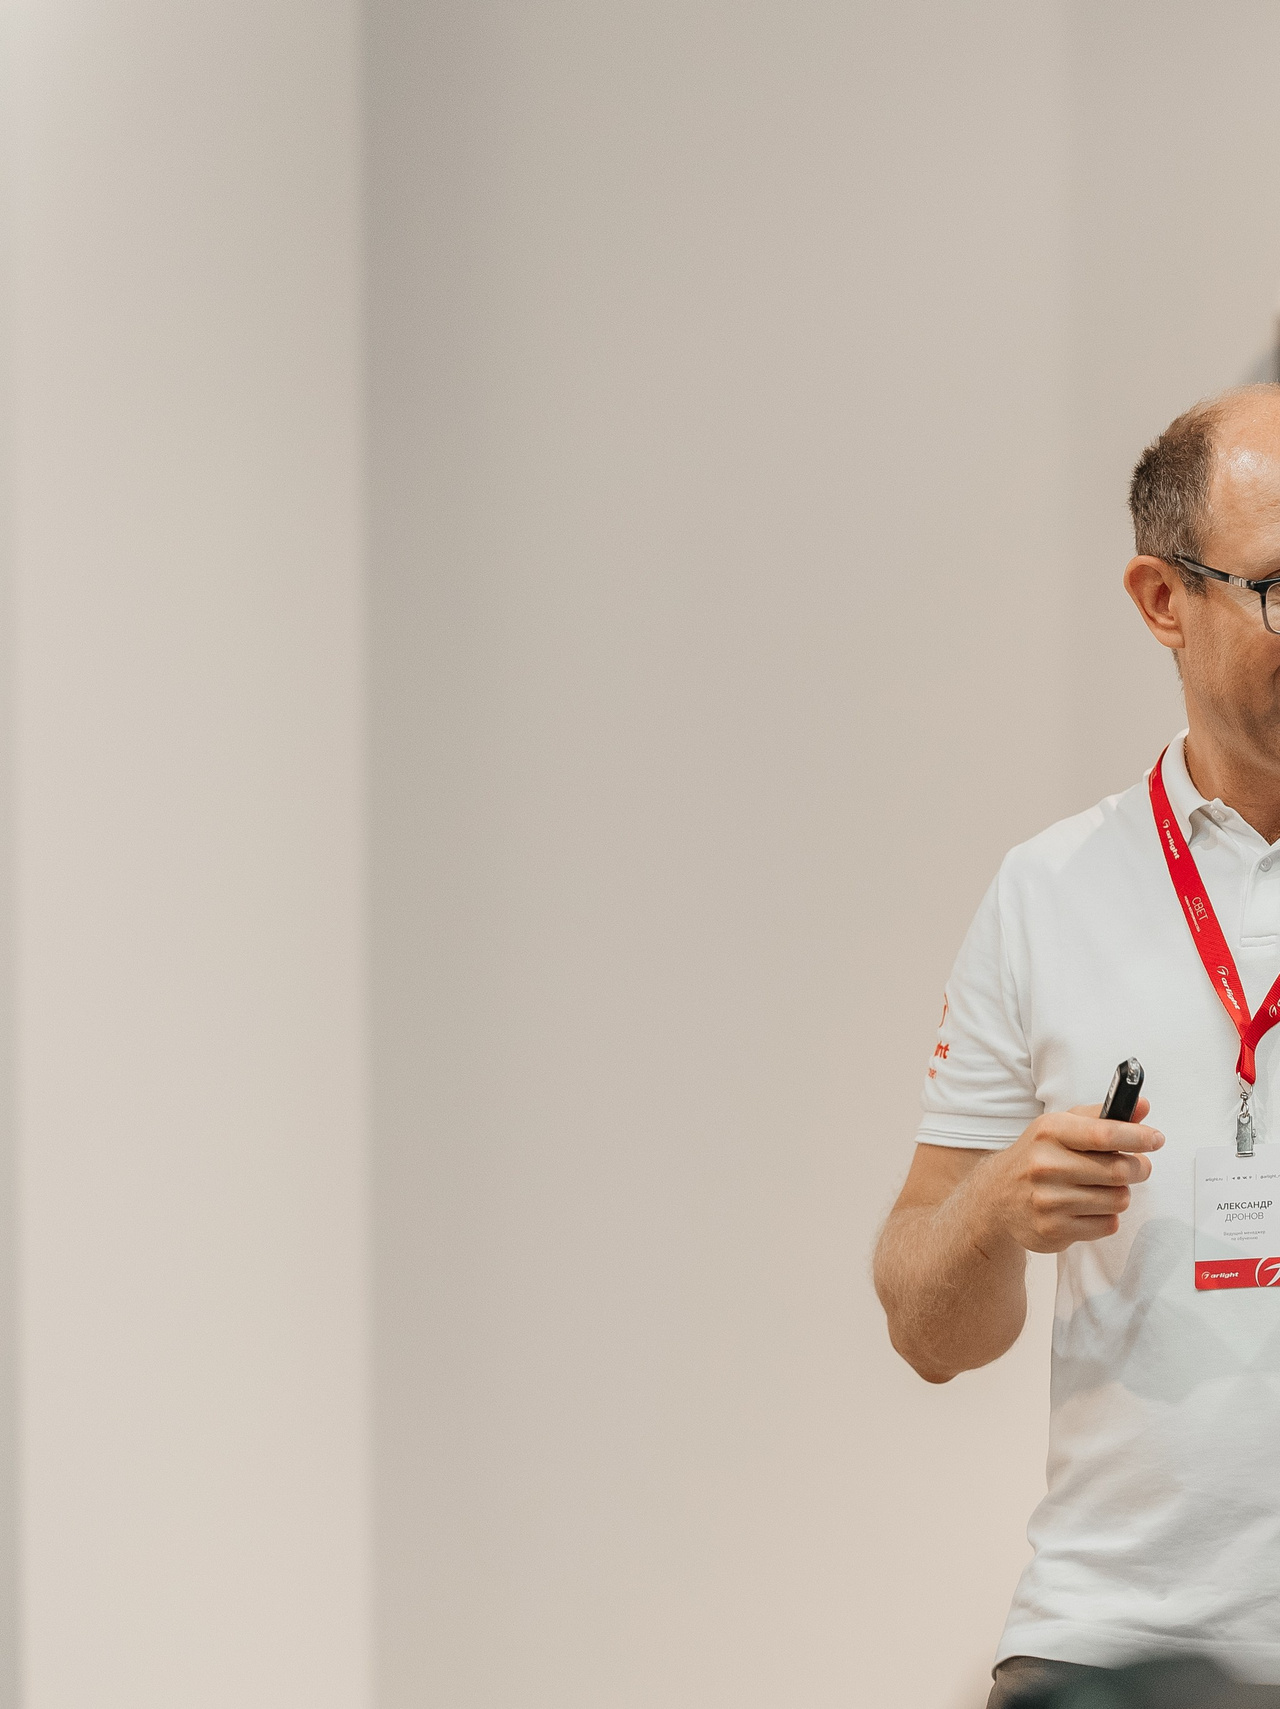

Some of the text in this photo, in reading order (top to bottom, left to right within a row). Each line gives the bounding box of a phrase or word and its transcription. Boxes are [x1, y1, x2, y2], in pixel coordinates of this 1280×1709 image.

[1165, 828, 1180, 860] arlight
[1221, 974, 1240, 1010] arlight
[1216, 1200, 1273, 1210] АЛЕКСАНДР
[1225, 1212, 1264, 1222] ДРОНОВ
[1210, 1271, 1239, 1279] arlight
